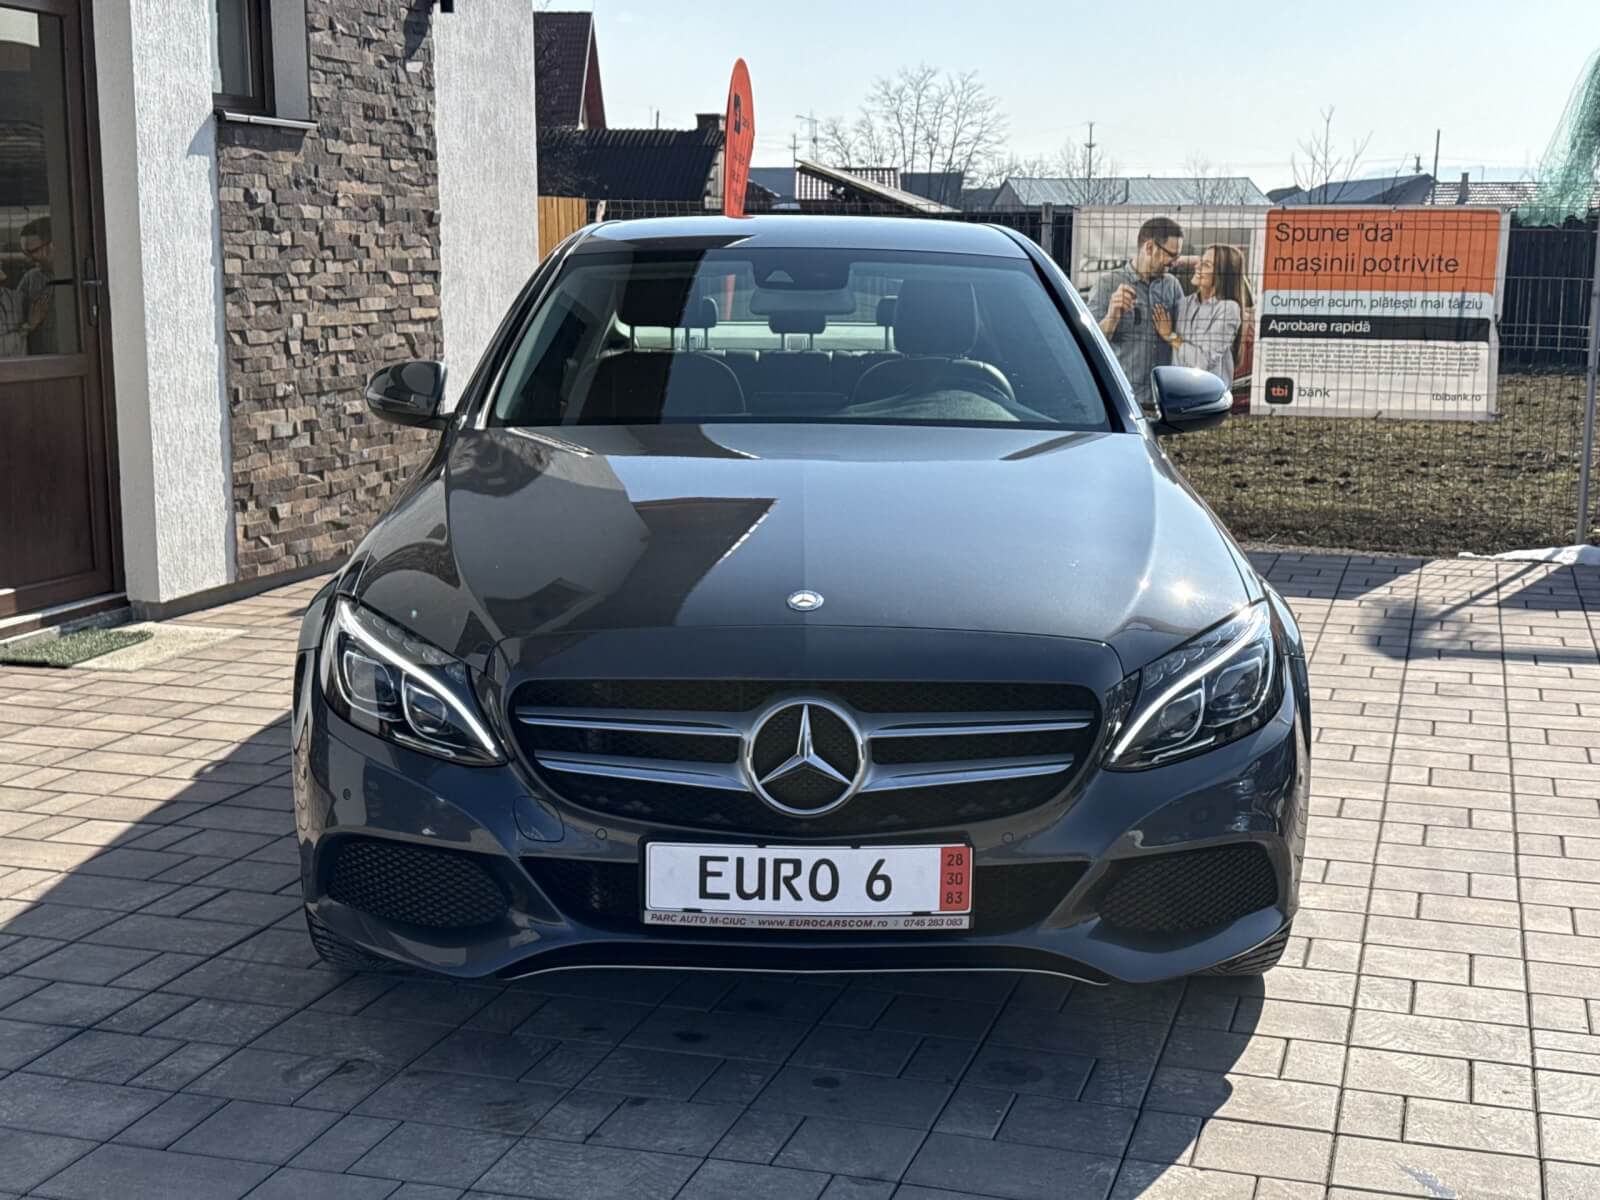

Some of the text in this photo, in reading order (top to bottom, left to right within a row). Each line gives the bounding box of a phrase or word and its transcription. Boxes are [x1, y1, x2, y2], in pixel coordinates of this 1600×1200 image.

[1275, 222, 1403, 246] Spune "da"
[1273, 253, 1459, 277] mașinii potrivite
[1270, 295, 1484, 313] Cumperi acum, plătești mai târziu
[1268, 319, 1371, 334] Aprobare rapidă
[1271, 386, 1331, 399] tbi bank
[946, 854, 964, 866] 28
[699, 855, 893, 902] EURO 6
[946, 873, 964, 885] 30
[945, 892, 963, 904] 83
[650, 913, 677, 922] PARC
[679, 915, 707, 924] AUTO
[709, 917, 747, 926] M-CIUC
[903, 919, 926, 927] 0745
[927, 919, 945, 927] 283
[946, 919, 963, 927] 083
